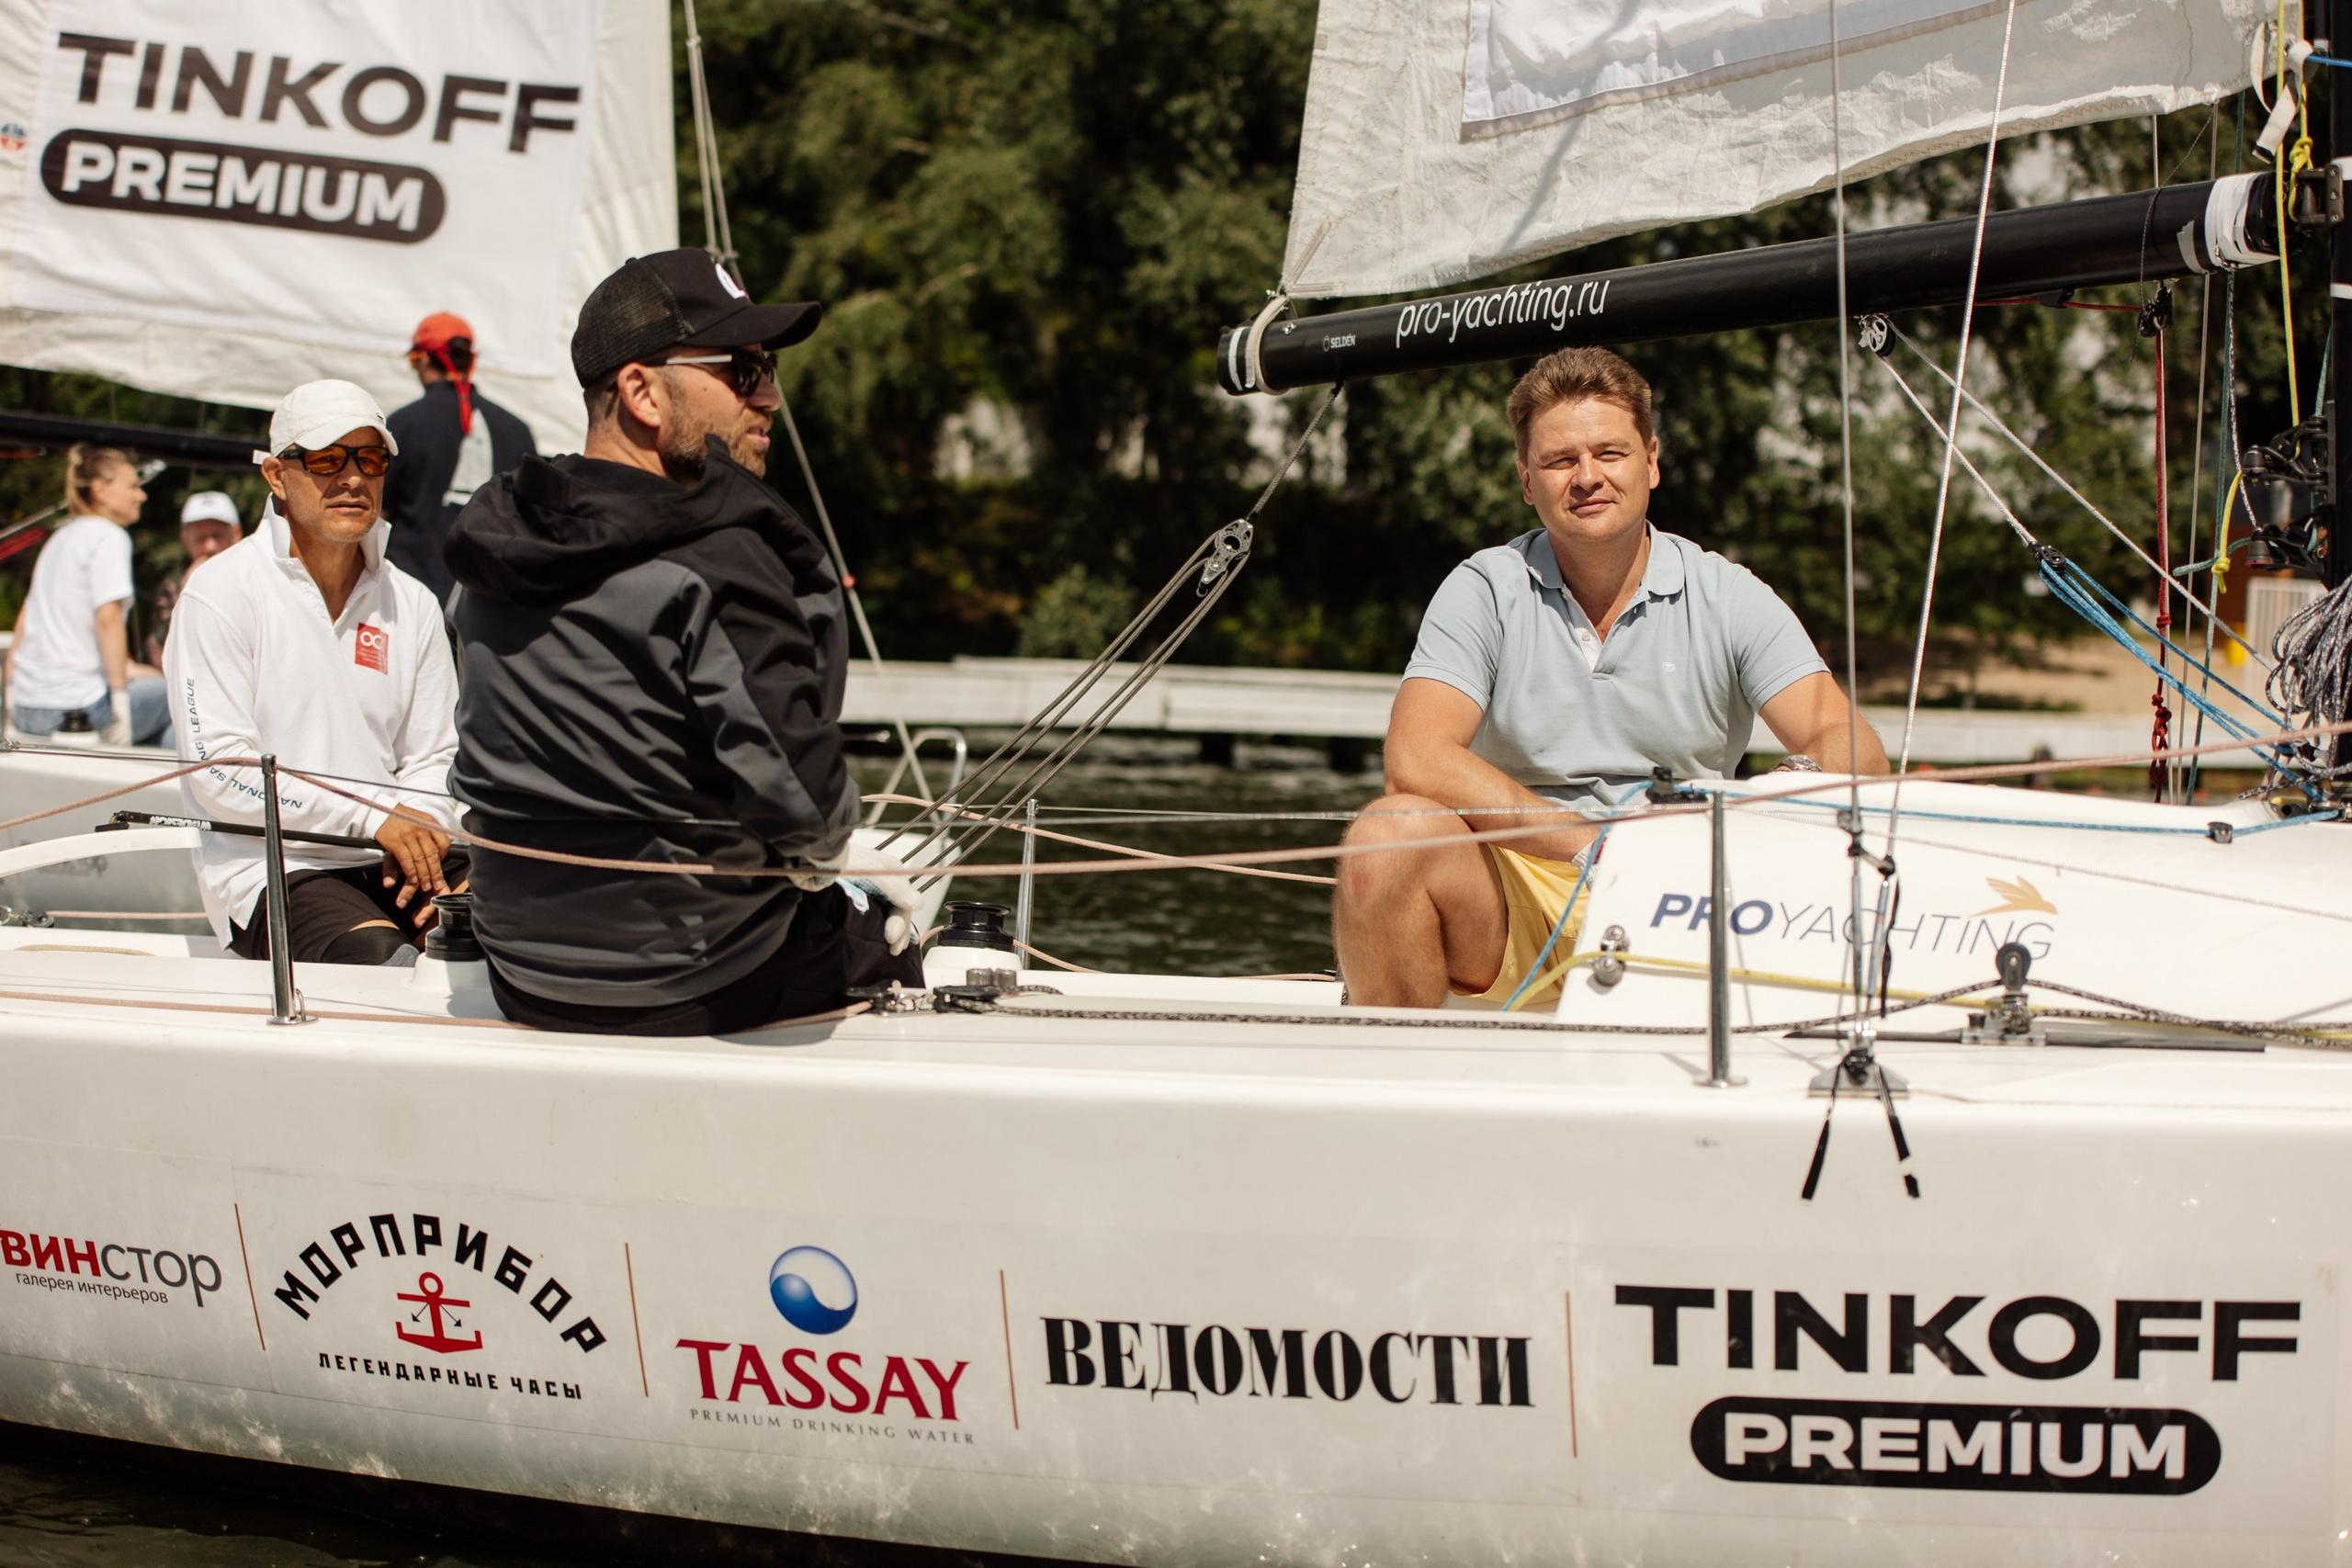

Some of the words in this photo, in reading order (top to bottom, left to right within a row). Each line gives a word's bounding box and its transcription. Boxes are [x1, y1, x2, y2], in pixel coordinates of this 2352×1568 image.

[57, 31, 582, 153] TINKOFF
[60, 140, 425, 233] PREMIUM
[1396, 280, 1610, 348] pro-yachting.ru
[187, 677, 201, 734] LEAGUE
[16, 1272, 75, 1292] галерея
[77, 1281, 169, 1304] интерьеров
[274, 1213, 607, 1354] МОРПРИБОР
[1040, 1316, 1536, 1407] ВЕДОМОСТИ
[1614, 1284, 2301, 1382] TINKOFF
[319, 1352, 499, 1391] ЛЕГЕНДАРНЫЕ
[510, 1376, 582, 1401] ЧАСЫ
[675, 1338, 971, 1422] TASSAY
[690, 1408, 781, 1428] PREMIUM
[793, 1417, 896, 1439] DRINKING
[908, 1428, 976, 1446] WATER
[1724, 1412, 2187, 1480] PREMIUM
